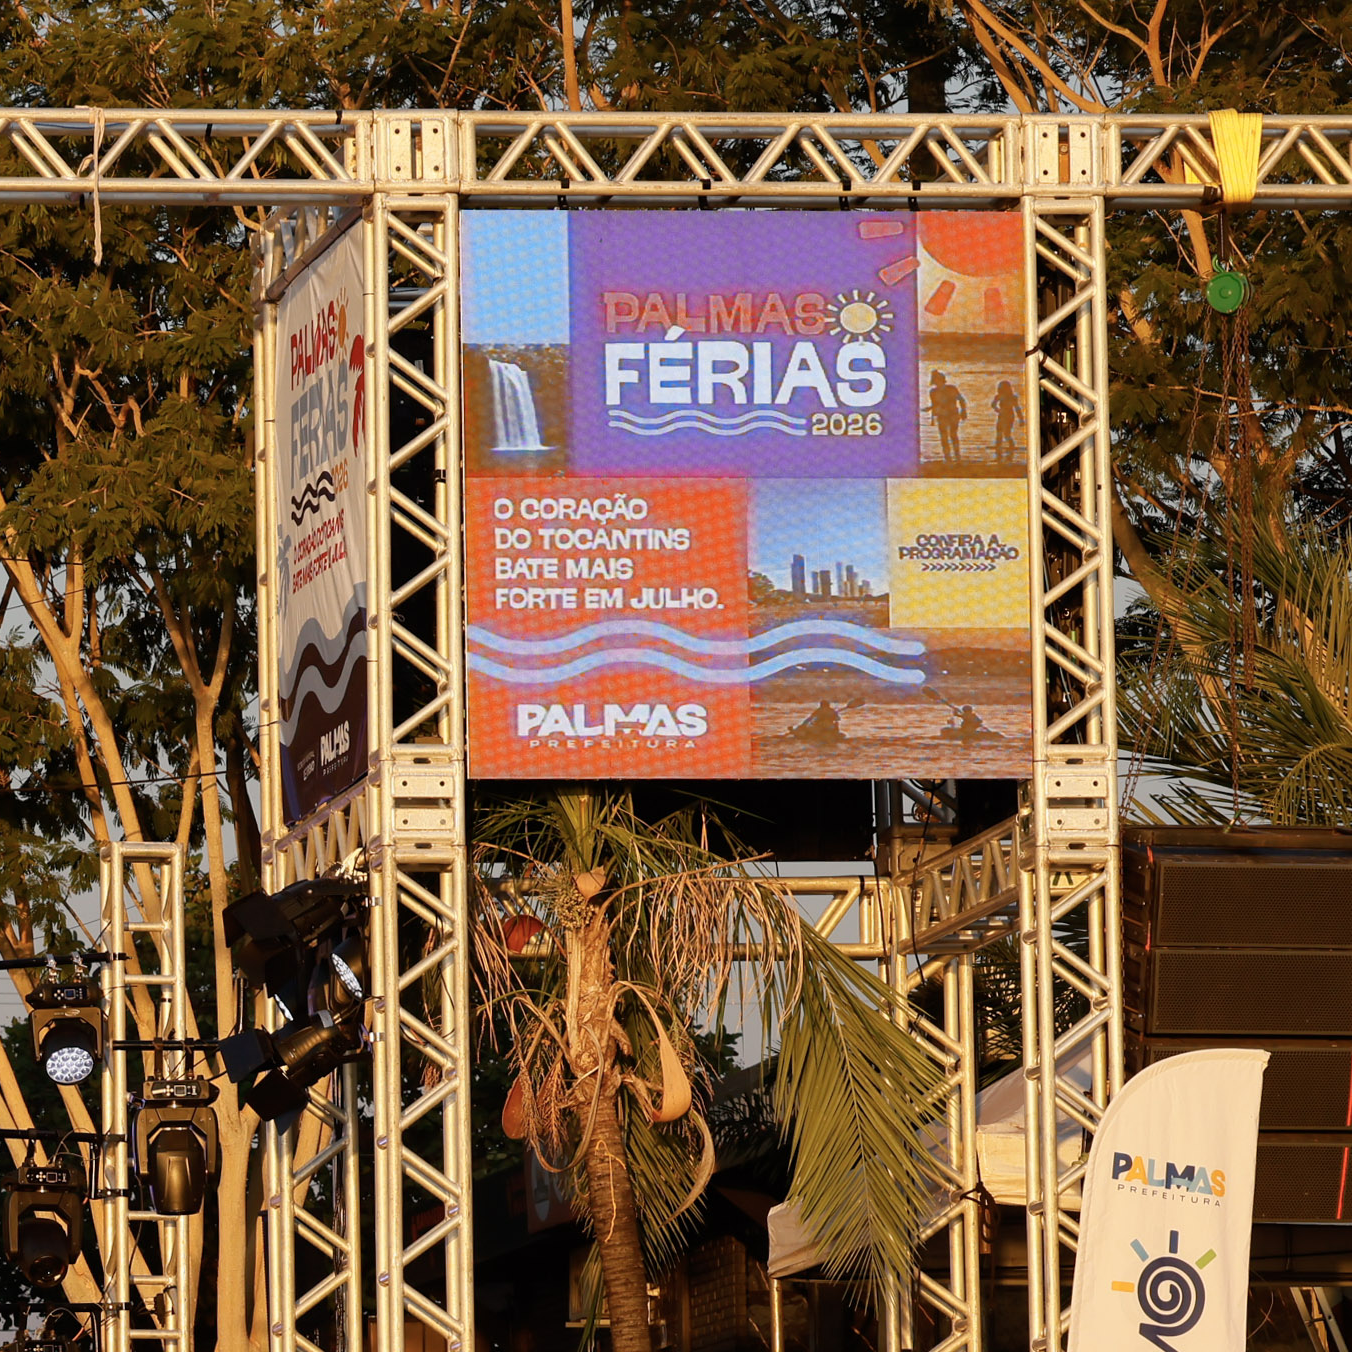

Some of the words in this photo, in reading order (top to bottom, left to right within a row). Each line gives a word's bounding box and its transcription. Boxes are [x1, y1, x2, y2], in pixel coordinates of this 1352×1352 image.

[603, 292, 825, 335] PALMAS
[604, 326, 887, 408] FÉRIAS
[812, 413, 882, 436] 2026
[493, 498, 514, 520] O
[520, 493, 648, 524] CORAÇÃO
[495, 528, 532, 550] DO
[538, 527, 691, 551] TOCANTINS
[916, 534, 985, 547] CONFIRA
[898, 544, 1020, 563] PROGRAMAÇÃO
[495, 557, 559, 580] BATE
[565, 557, 634, 580] MAIS
[496, 588, 577, 610] FORTE
[584, 588, 623, 610] EM
[631, 587, 725, 609] JULHO.
[517, 704, 708, 739] PALMAS
[529, 739, 696, 750] PREFEITURA
[1112, 1151, 1226, 1198] PALMAS
[1117, 1184, 1222, 1207] PREFEITURA
